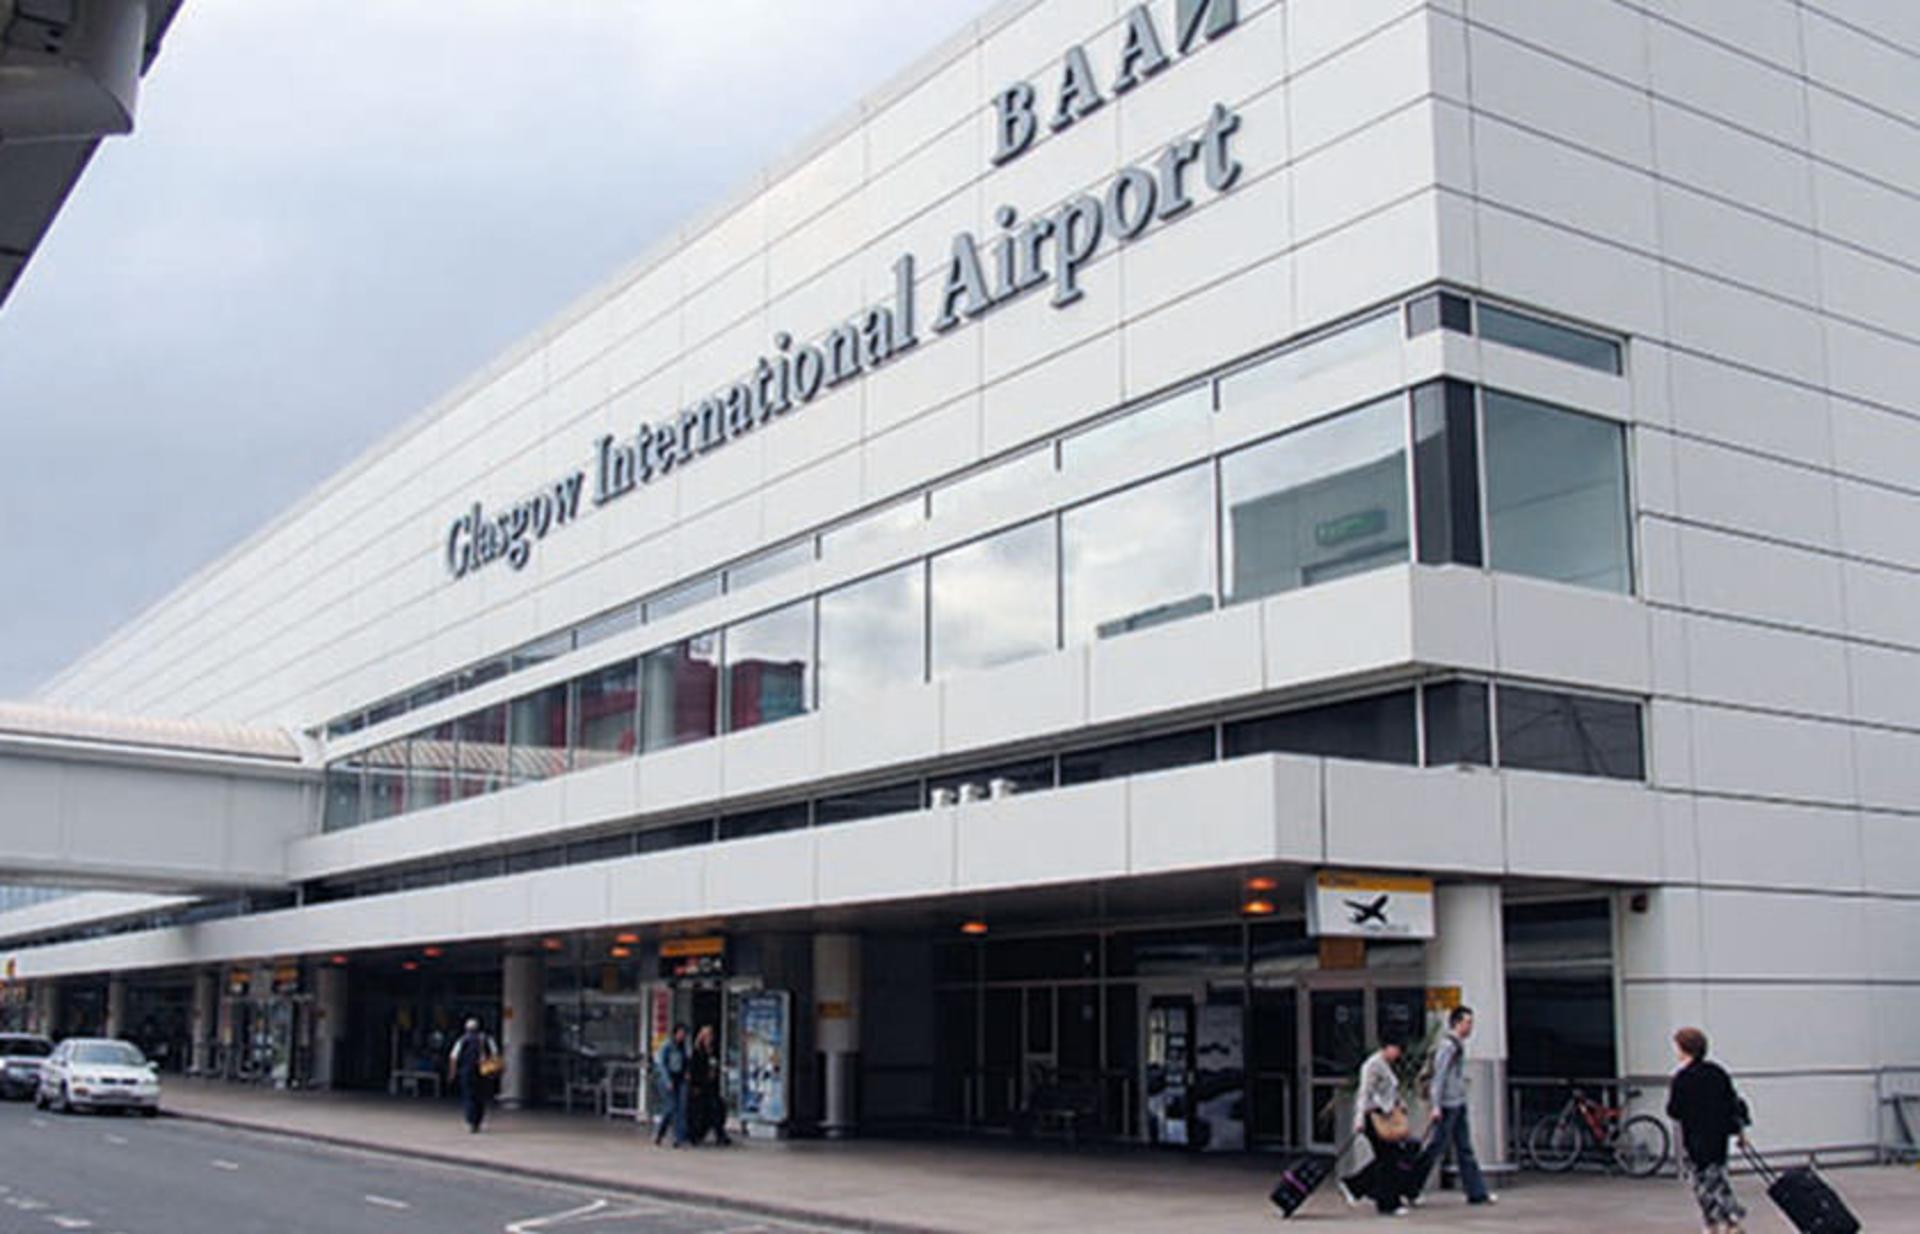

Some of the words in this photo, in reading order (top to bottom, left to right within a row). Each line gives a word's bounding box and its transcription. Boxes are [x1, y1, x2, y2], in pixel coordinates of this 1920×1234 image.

[447, 471, 584, 579] Glasgow
[593, 253, 918, 506] International
[931, 102, 1242, 334] Airport
